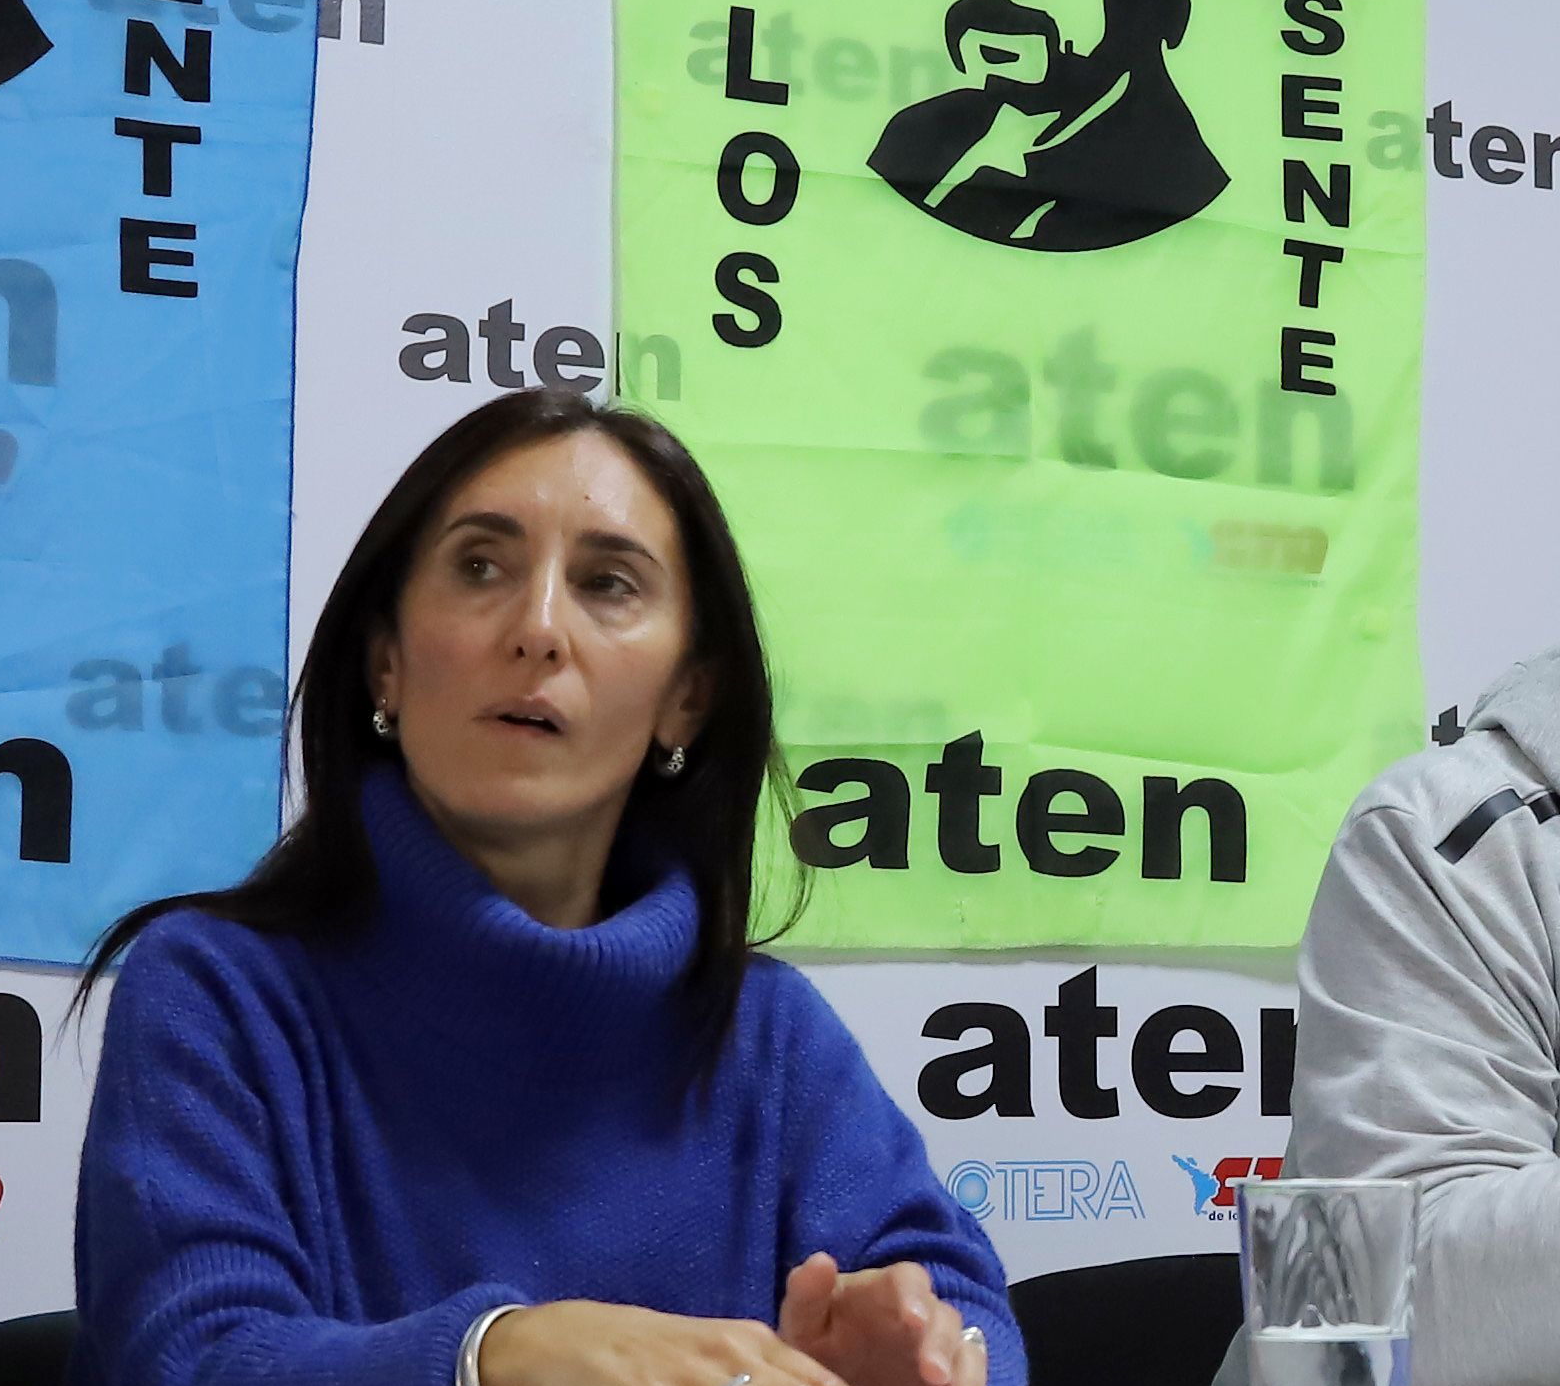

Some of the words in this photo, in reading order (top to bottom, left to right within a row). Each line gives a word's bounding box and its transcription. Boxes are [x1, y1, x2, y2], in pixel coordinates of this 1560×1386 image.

[398, 298, 681, 401] aten
[919, 325, 1357, 495] aten
[65, 642, 285, 741] ate
[790, 729, 1249, 883] aten
[1208, 1210, 1225, 1221] de
